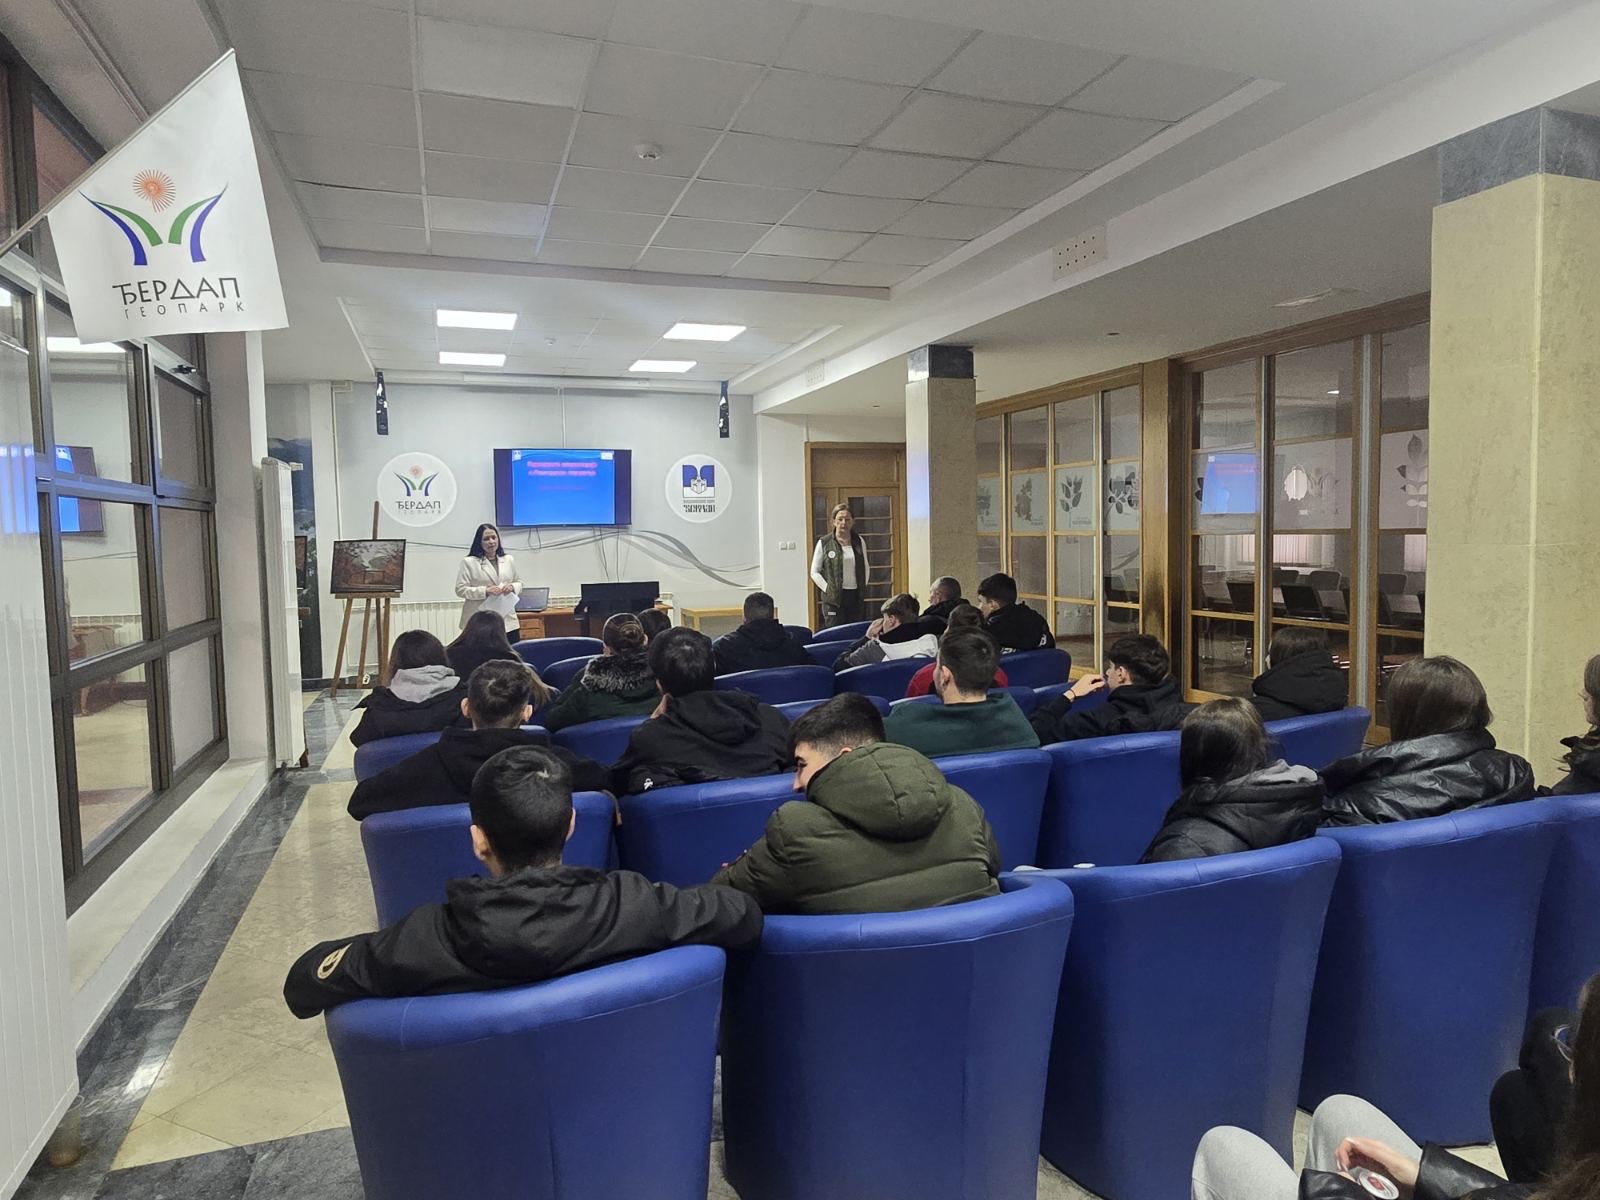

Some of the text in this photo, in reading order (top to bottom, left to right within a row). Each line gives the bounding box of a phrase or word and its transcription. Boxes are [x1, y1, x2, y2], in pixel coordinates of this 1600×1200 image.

[112, 277, 240, 305] ЂЕРДАП
[125, 302, 244, 320] ГЕОПАРК
[395, 500, 441, 510] ЂЕРДАП
